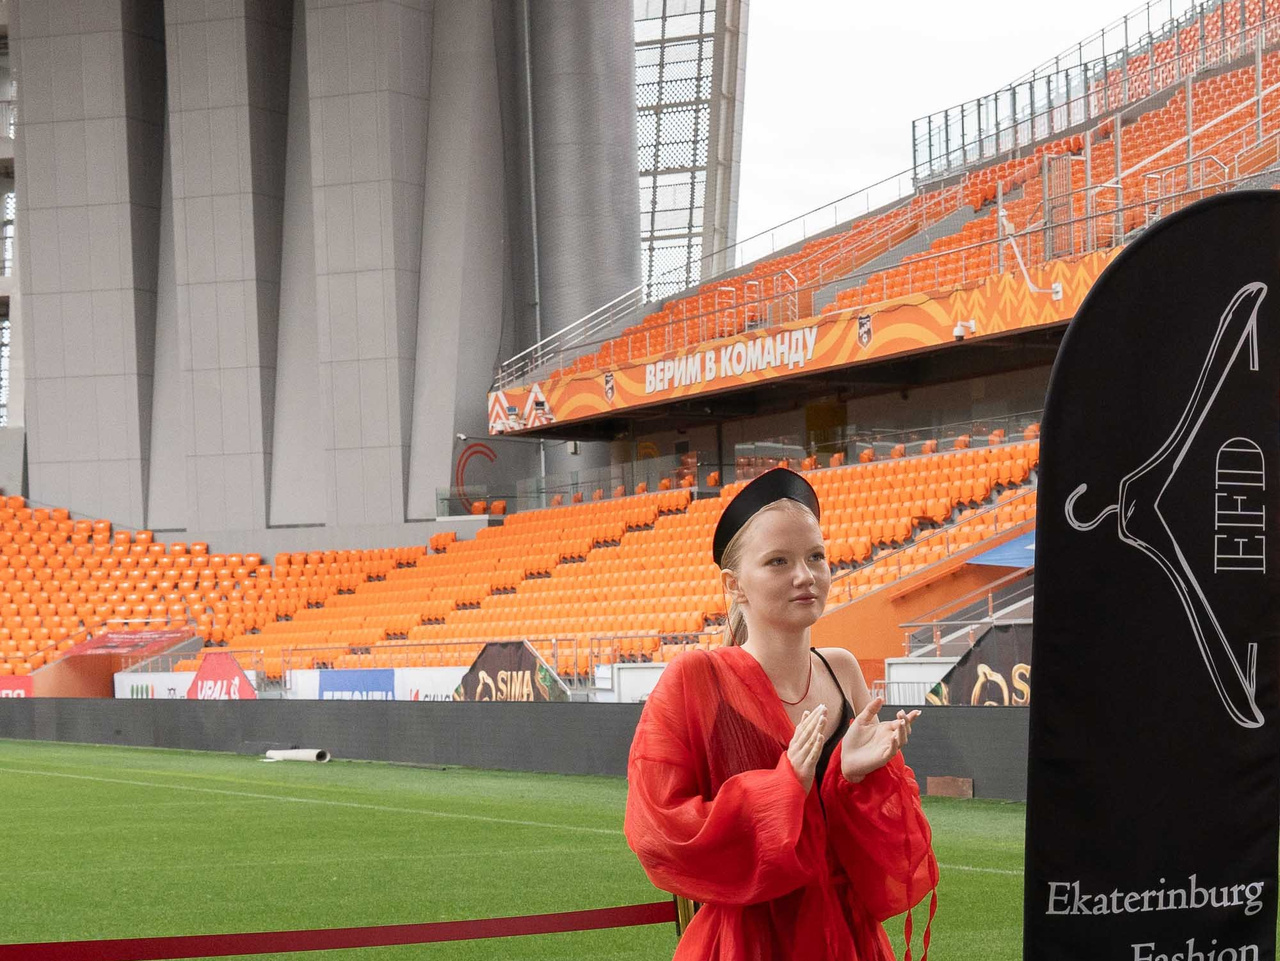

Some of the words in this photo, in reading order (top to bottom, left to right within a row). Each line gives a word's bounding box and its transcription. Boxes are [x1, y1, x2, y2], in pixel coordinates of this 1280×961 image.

[645, 352, 702, 394] ВЕРИМ
[705, 350, 717, 382] В
[720, 326, 818, 378] КОМАНДУ
[1213, 436, 1266, 574] EFD
[496, 670, 535, 702] SIMA
[1045, 873, 1265, 916] Ekaterinburg
